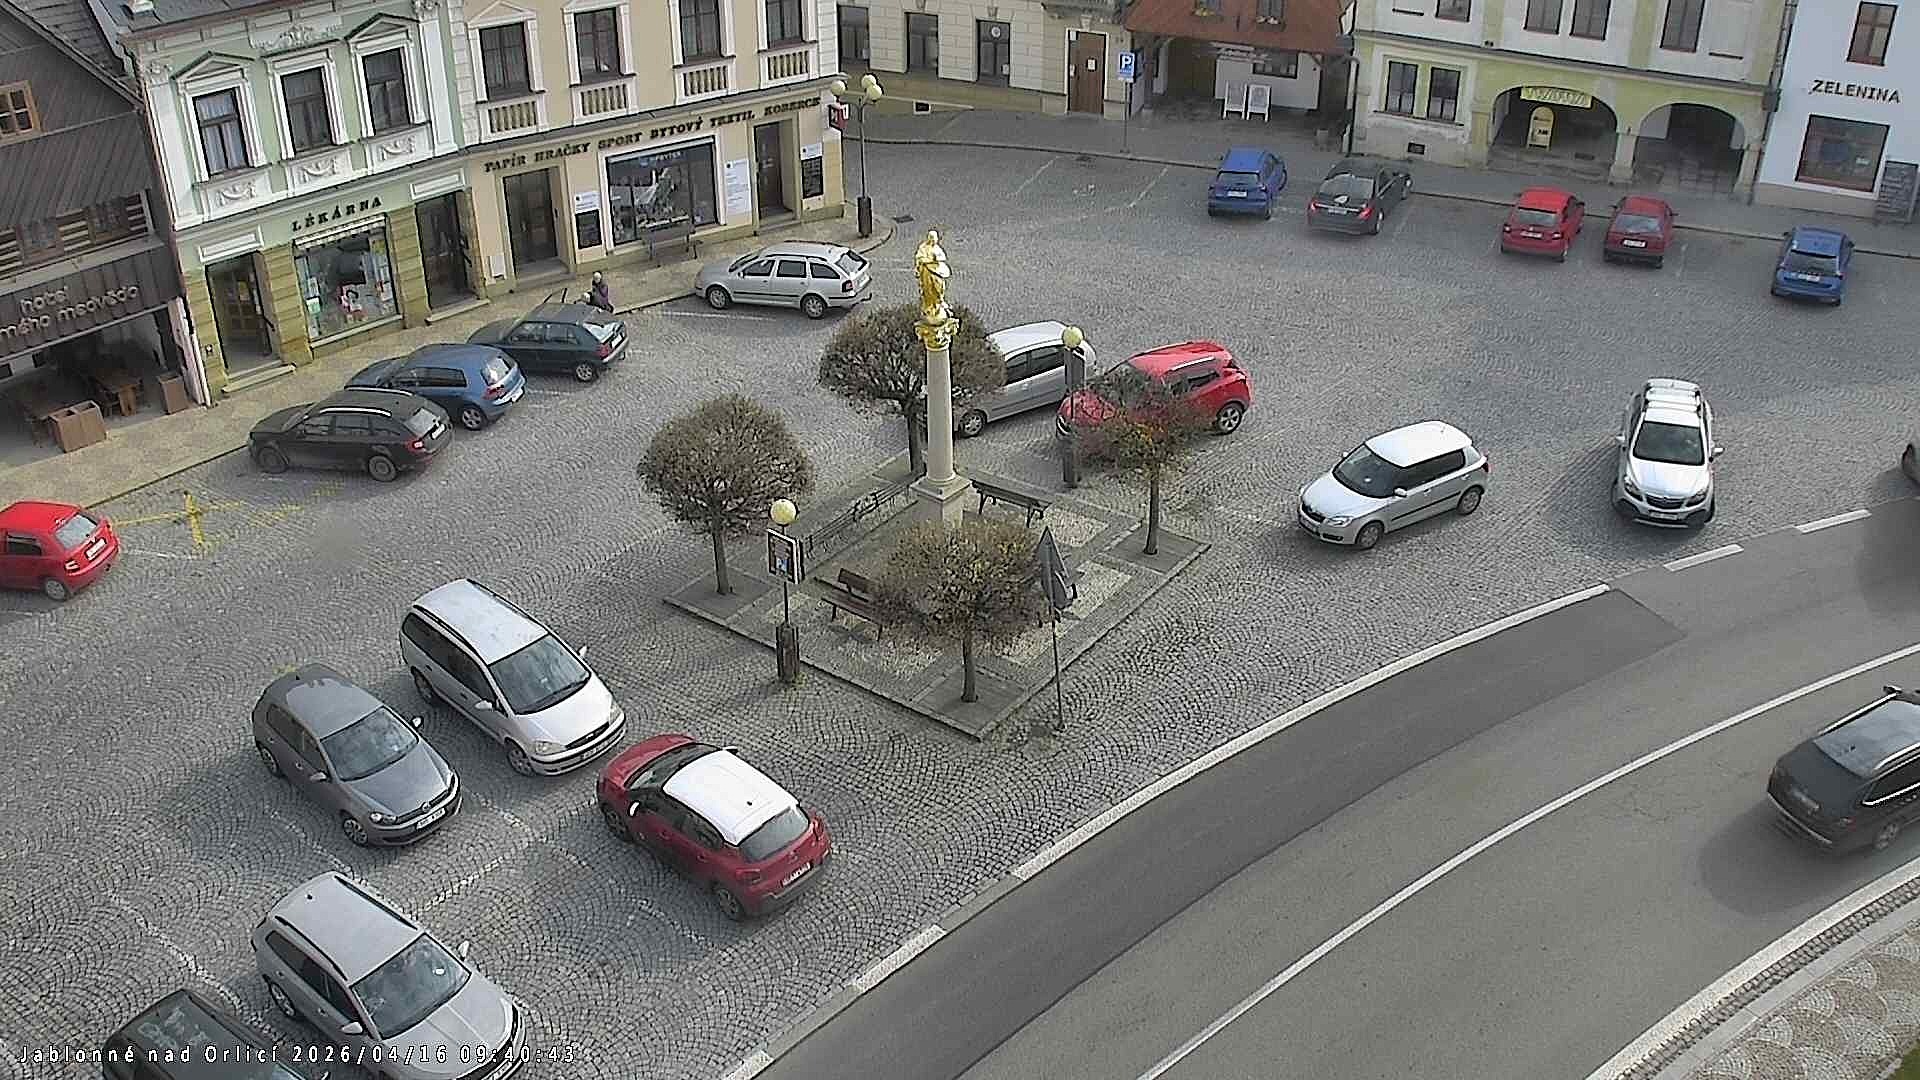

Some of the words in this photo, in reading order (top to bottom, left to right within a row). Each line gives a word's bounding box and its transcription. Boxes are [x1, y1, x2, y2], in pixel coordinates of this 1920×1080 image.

[1121, 55, 1132, 69] P
[1812, 79, 1901, 104] ZELENINA
[484, 152, 528, 173] PAPÍR
[535, 142, 591, 163] HRAČKY
[598, 132, 643, 150] SPORT
[650, 116, 704, 140] BYTOVÝ
[292, 196, 382, 232] LÉKÁRNA
[20, 285, 69, 314] hote
